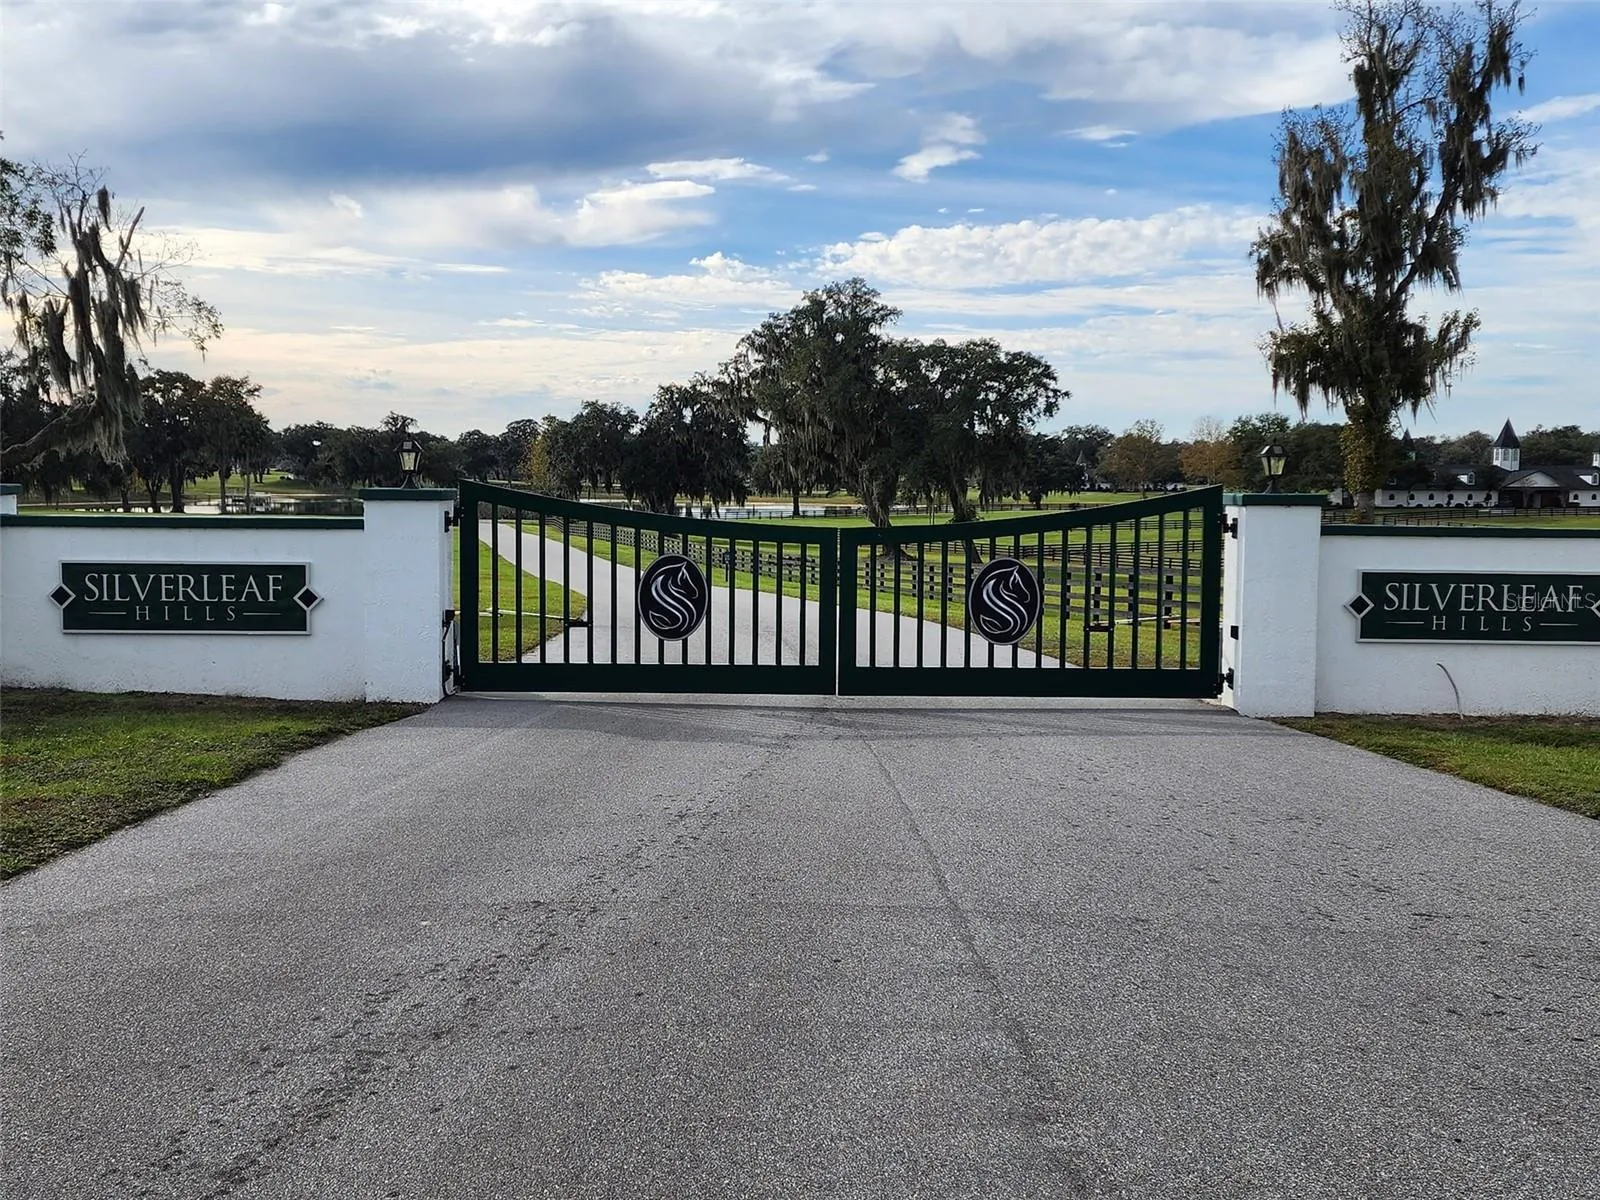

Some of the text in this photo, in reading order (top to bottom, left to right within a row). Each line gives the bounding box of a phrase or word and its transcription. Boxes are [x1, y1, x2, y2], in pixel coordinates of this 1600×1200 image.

[84, 573, 283, 602] SILVERLEAF
[1384, 583, 1583, 612] SILVERLEAF
[136, 606, 236, 621] HILLS
[1432, 616, 1532, 631] HILLS
